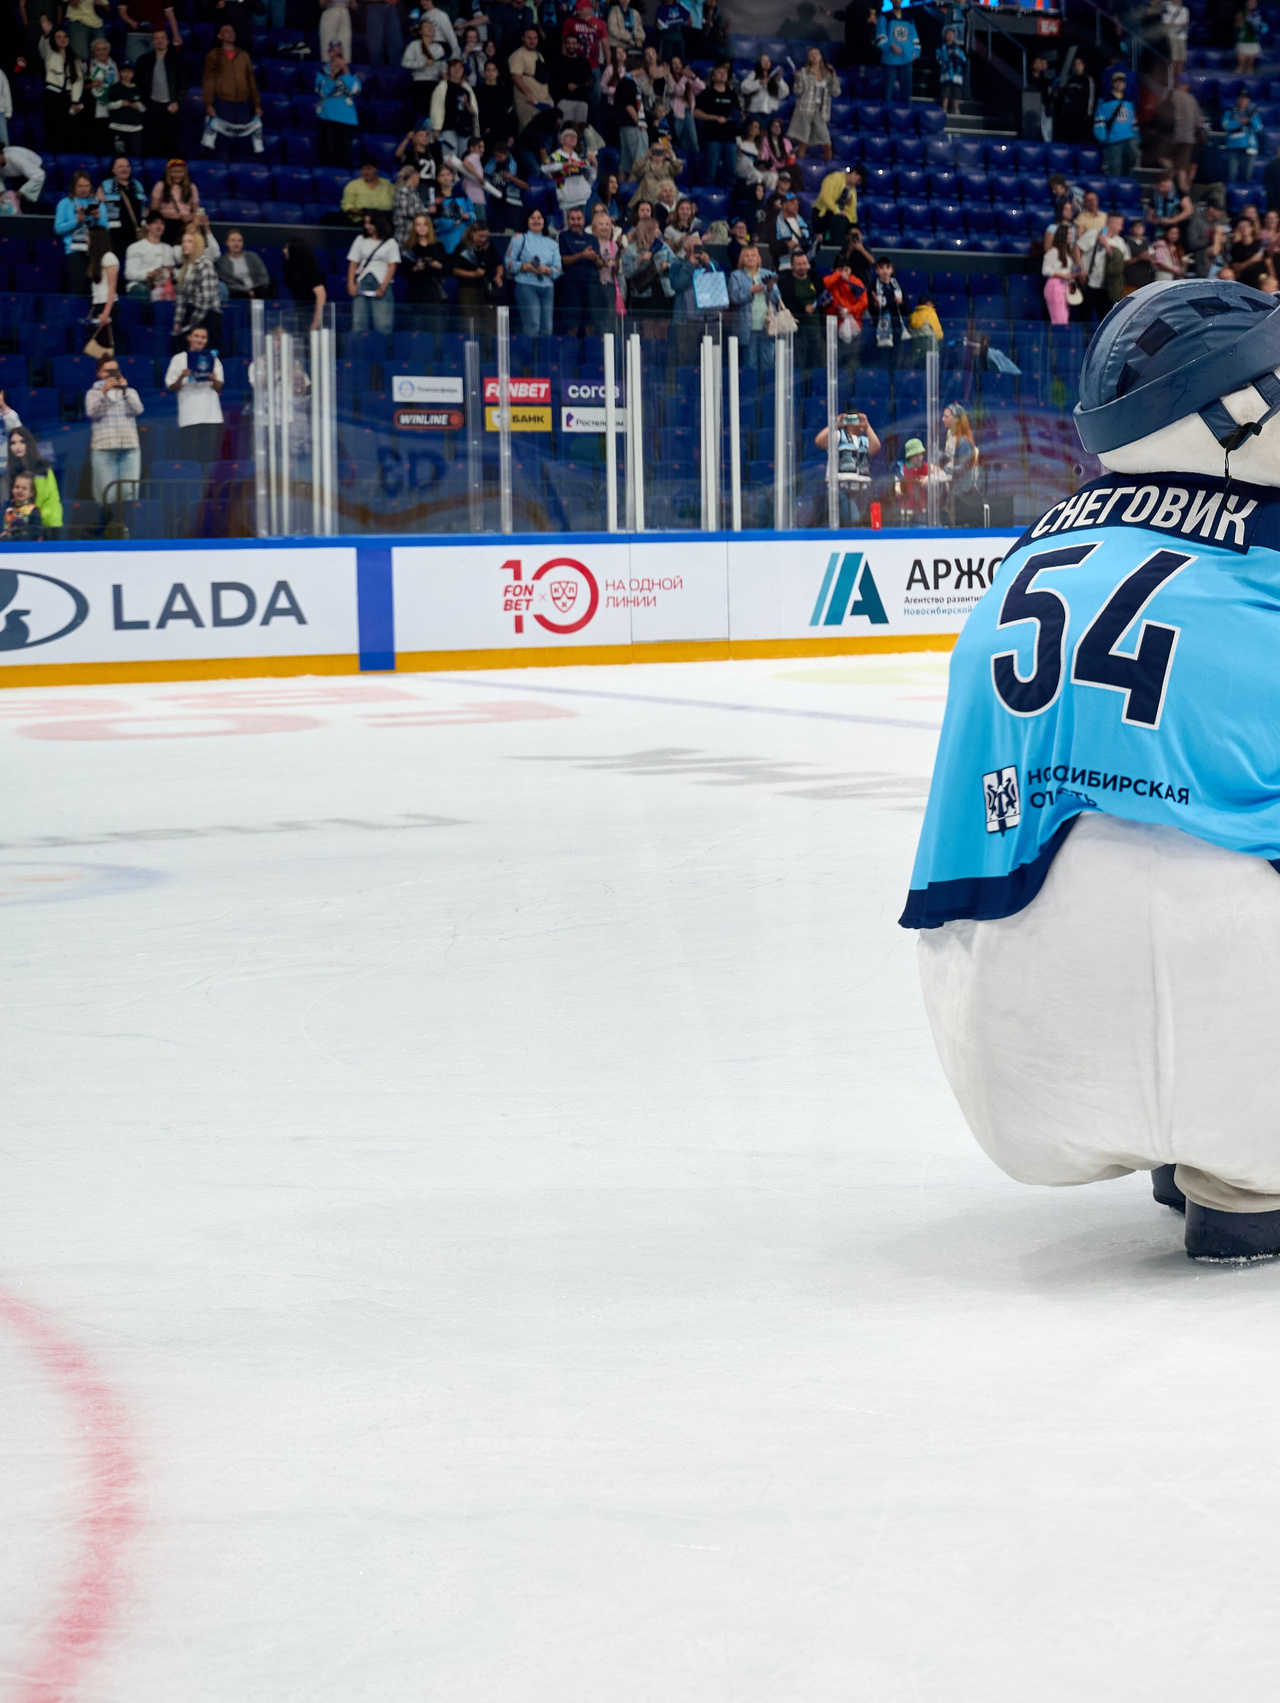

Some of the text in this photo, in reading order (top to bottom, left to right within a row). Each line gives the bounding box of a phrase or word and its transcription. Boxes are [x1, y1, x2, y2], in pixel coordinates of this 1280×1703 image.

[399, 413, 449, 426] WINLINE
[512, 414, 545, 424] БАНК
[1030, 485, 1259, 547] СНЕГОВИК
[503, 584, 535, 597] FON
[605, 575, 684, 593] НА ОДНОЙ
[111, 580, 309, 631] LADA
[503, 599, 533, 612] BET
[605, 596, 657, 608] ЛИНИИ
[904, 596, 945, 604] Агентство
[990, 541, 1200, 731] 54
